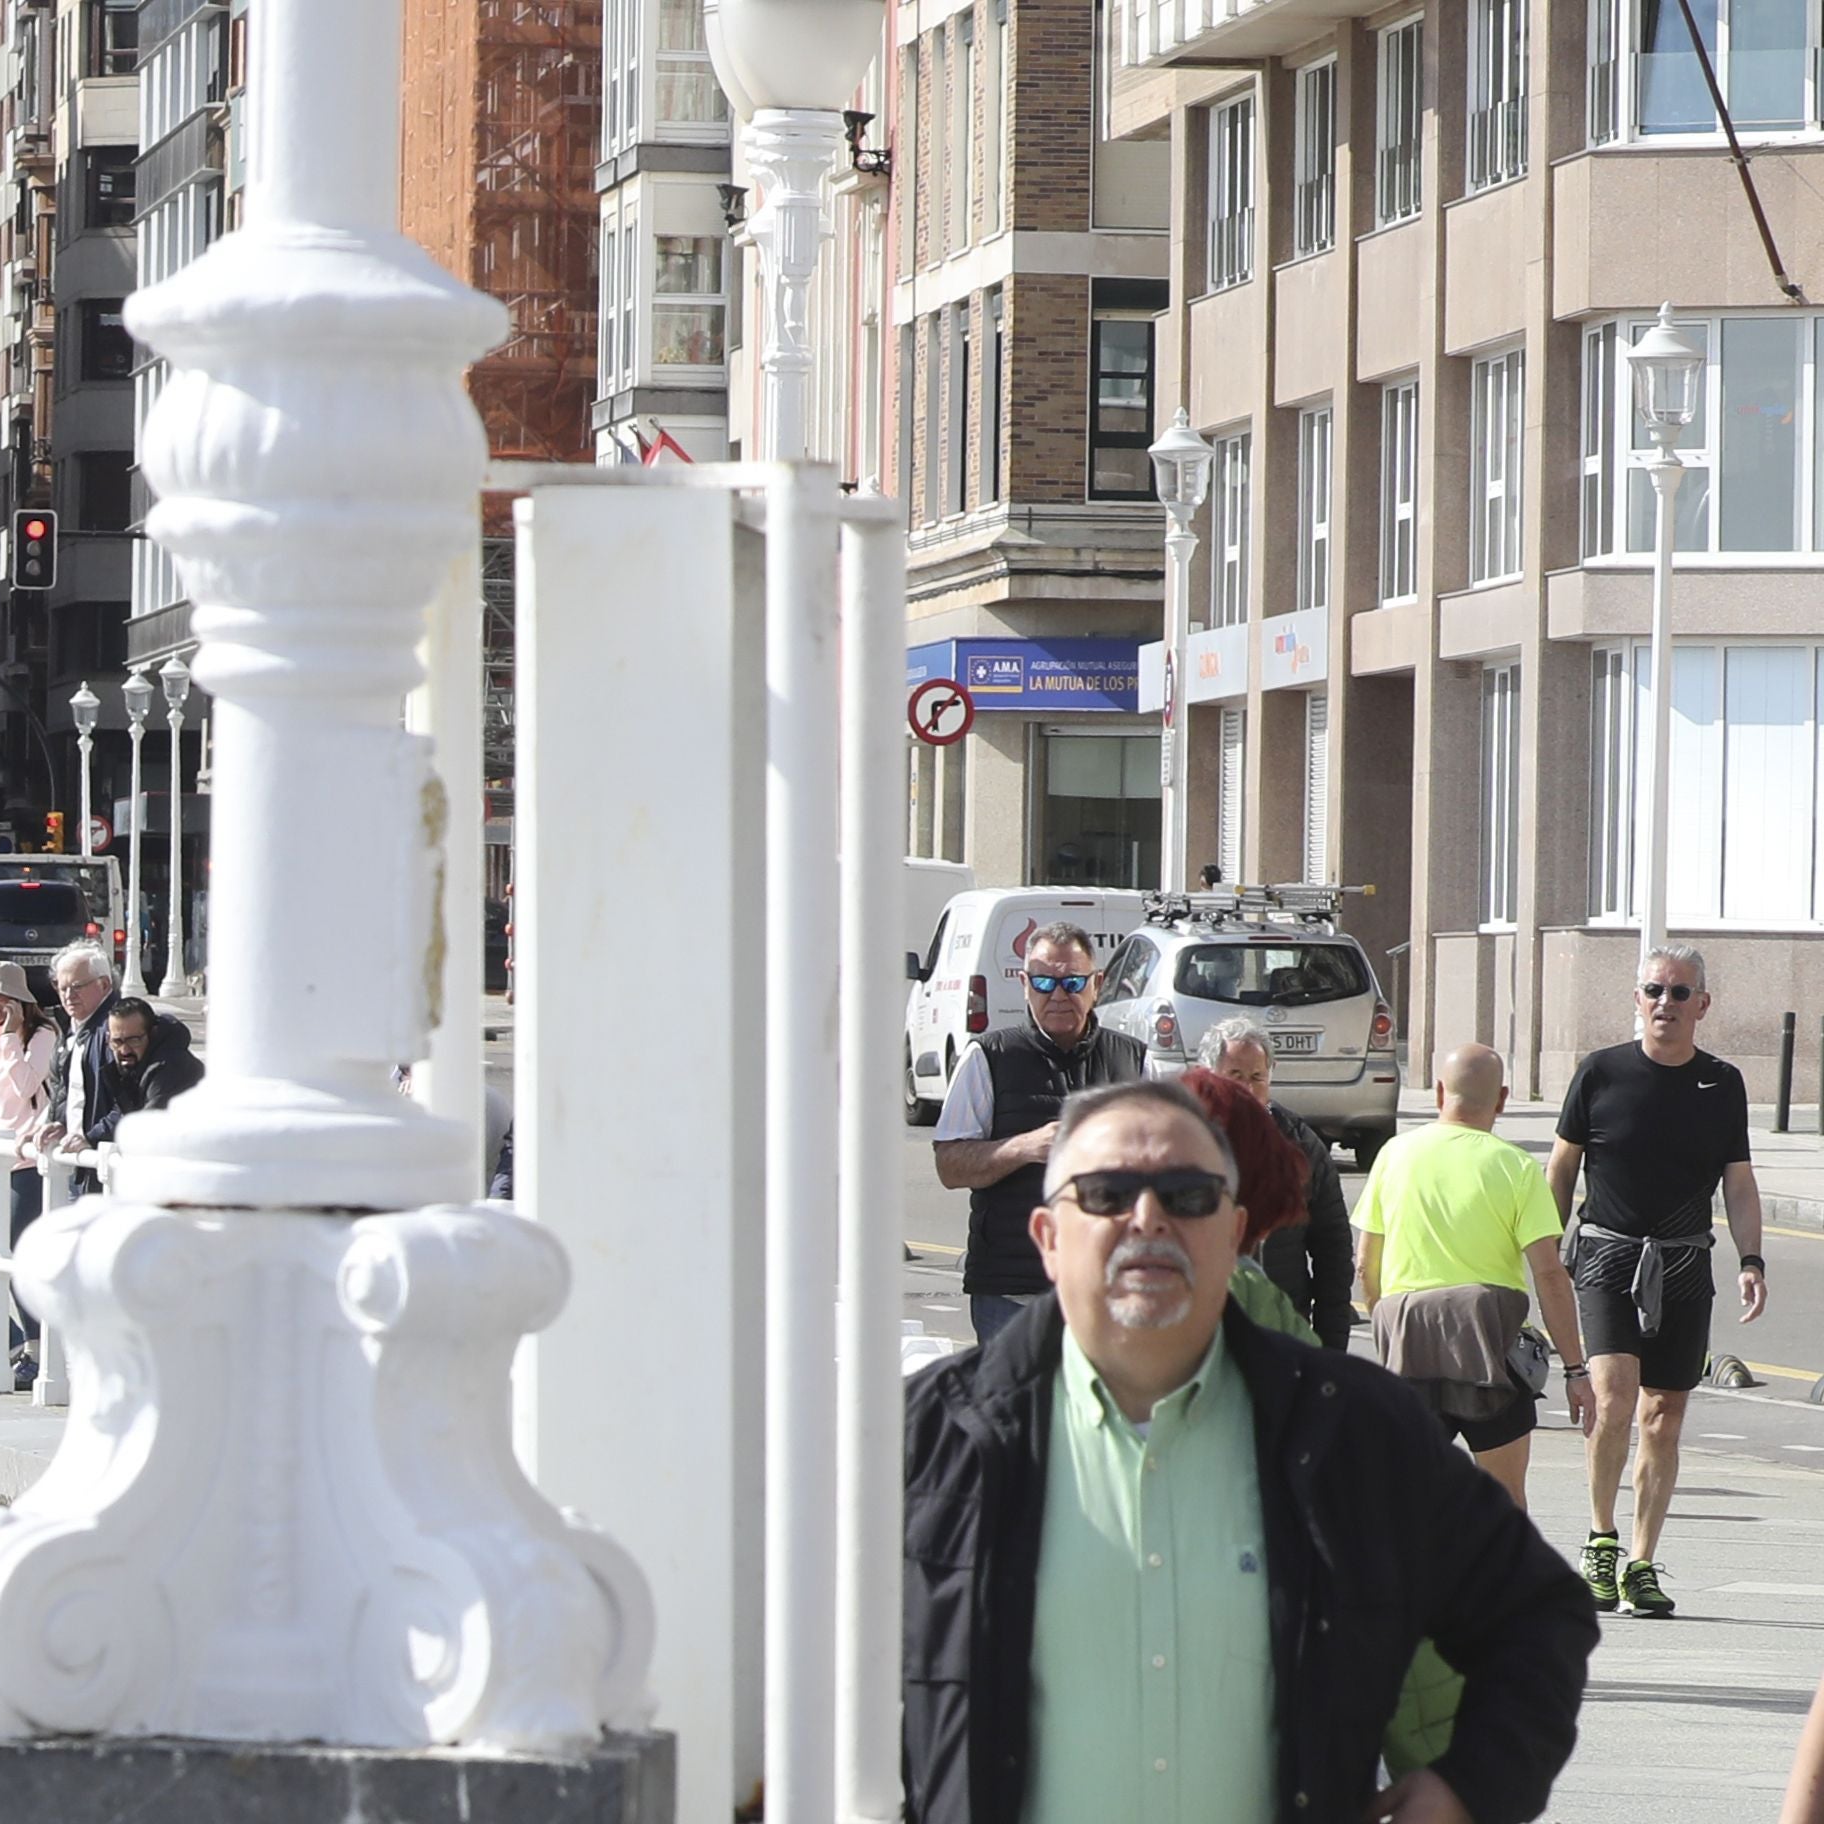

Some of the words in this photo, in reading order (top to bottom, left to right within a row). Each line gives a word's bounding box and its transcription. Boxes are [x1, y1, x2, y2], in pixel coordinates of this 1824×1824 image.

[1030, 676, 1043, 691] LA
[1045, 676, 1084, 691] MUTUA
[1087, 676, 1101, 691] DE
[1104, 676, 1125, 691] LOS
[1286, 1035, 1313, 1049] DHT
